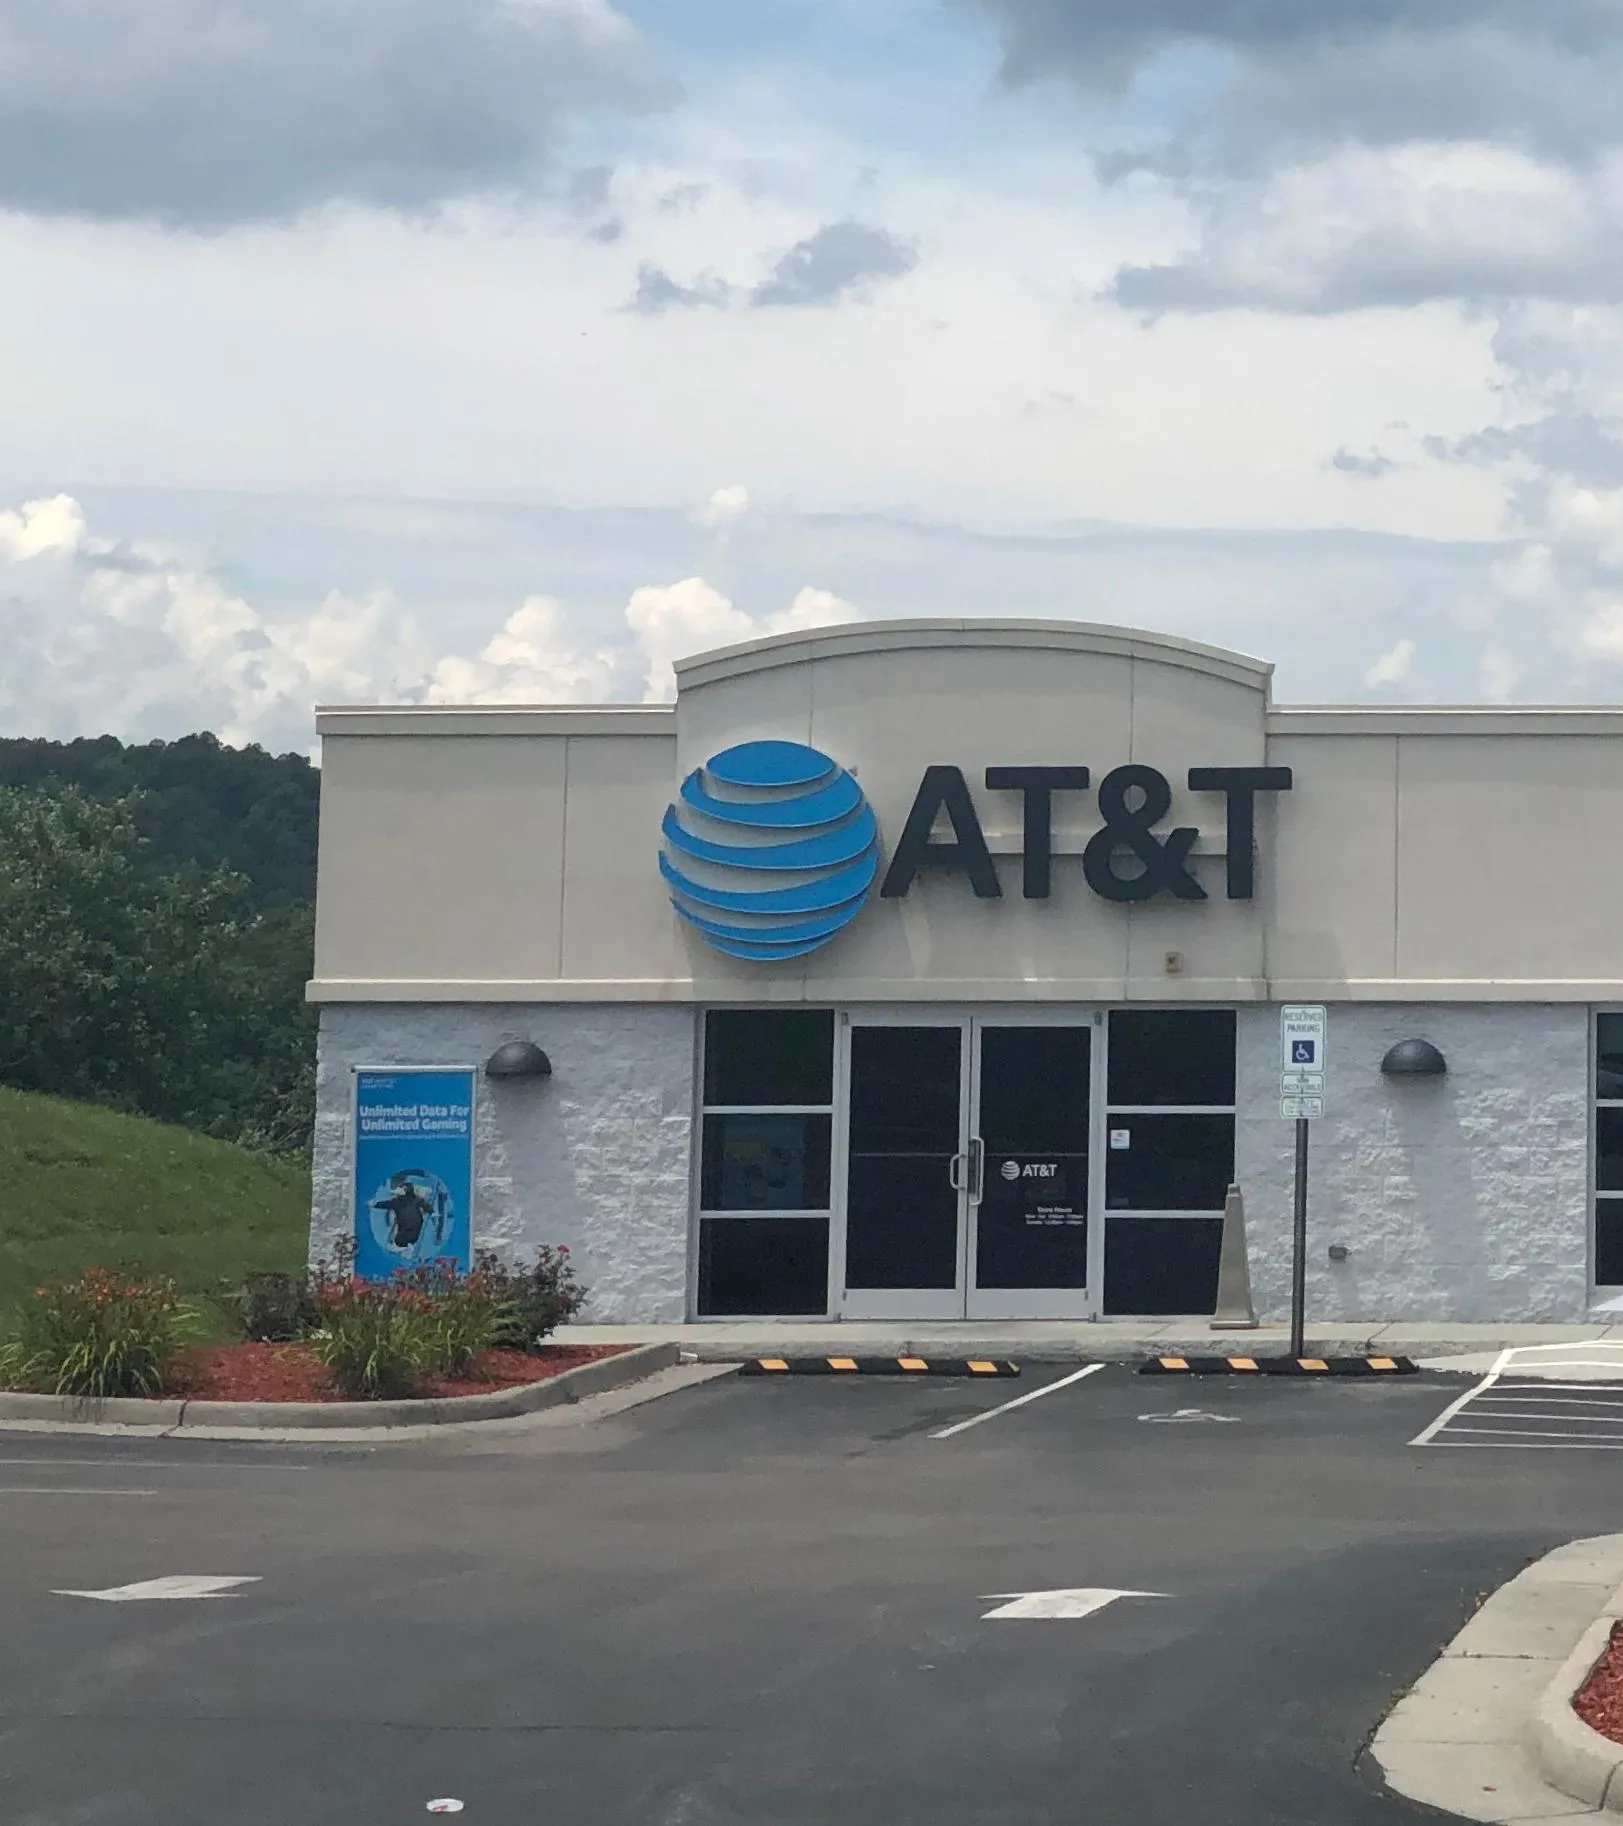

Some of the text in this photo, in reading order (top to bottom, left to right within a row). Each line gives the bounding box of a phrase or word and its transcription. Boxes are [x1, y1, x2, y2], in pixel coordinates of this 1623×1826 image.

[880, 764, 1292, 900] AT&T
[1287, 1024, 1321, 1033] PARKING
[359, 1104, 470, 1117] Unlimited Data For
[361, 1118, 467, 1132] Unlimited Gaming
[1022, 1164, 1058, 1177] AT&T
